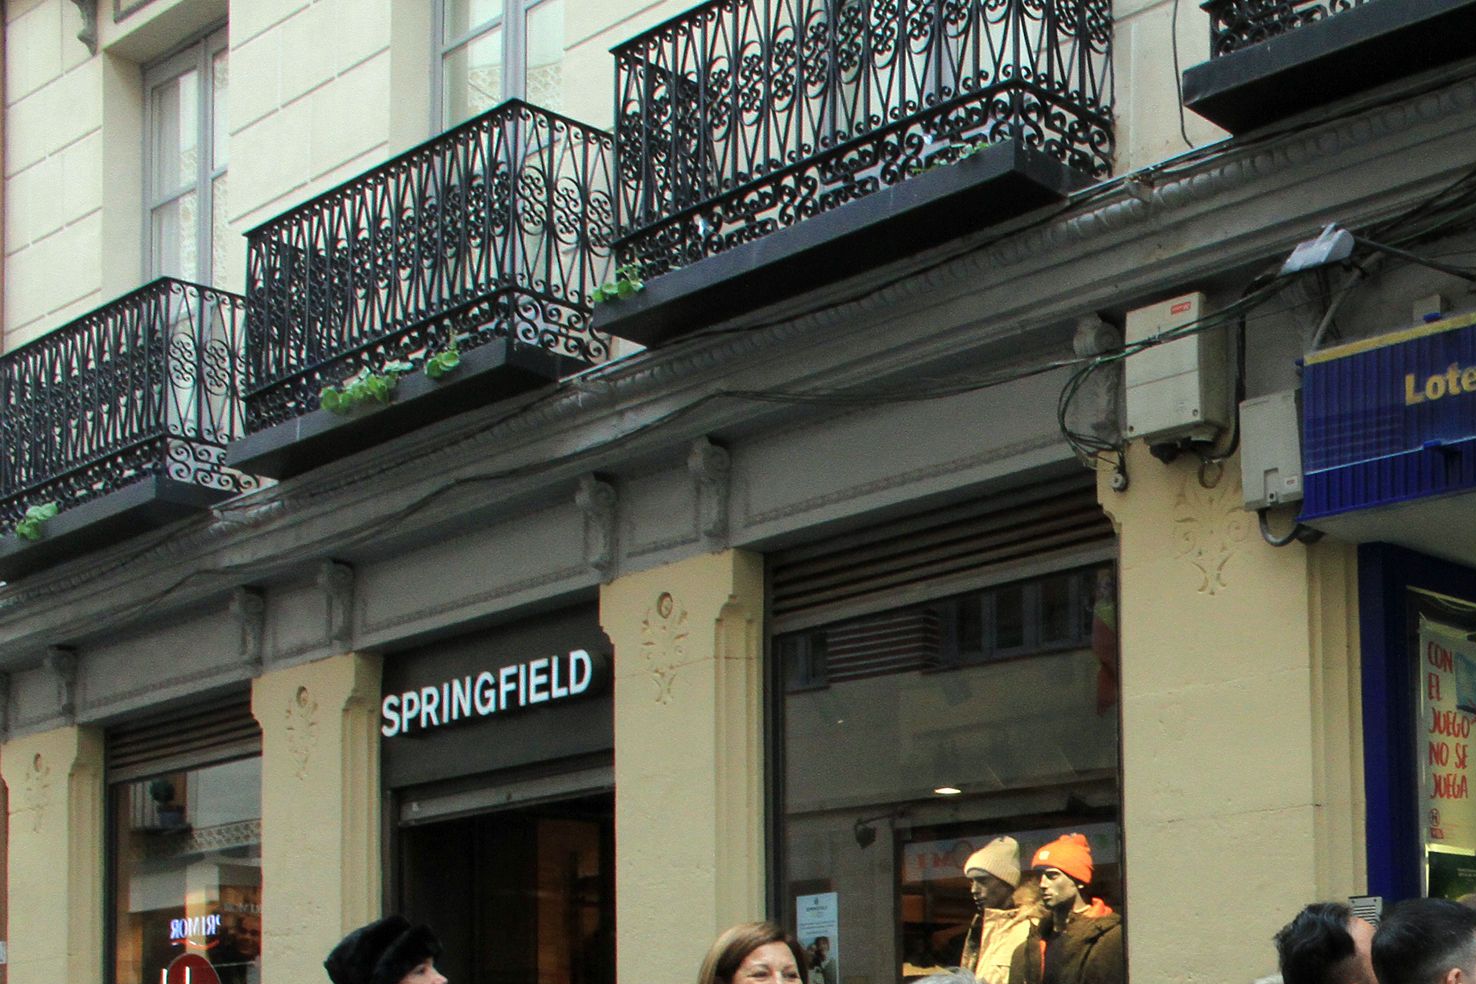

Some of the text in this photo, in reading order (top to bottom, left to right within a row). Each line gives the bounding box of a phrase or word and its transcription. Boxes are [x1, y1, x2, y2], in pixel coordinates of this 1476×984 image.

[1427, 640, 1453, 673] CON
[381, 649, 593, 738] SPRINGFIELD
[1427, 672, 1442, 701] EL
[1429, 707, 1471, 739] JUEGO
[1428, 741, 1469, 769] NO SE
[1430, 773, 1469, 800] JUEGA
